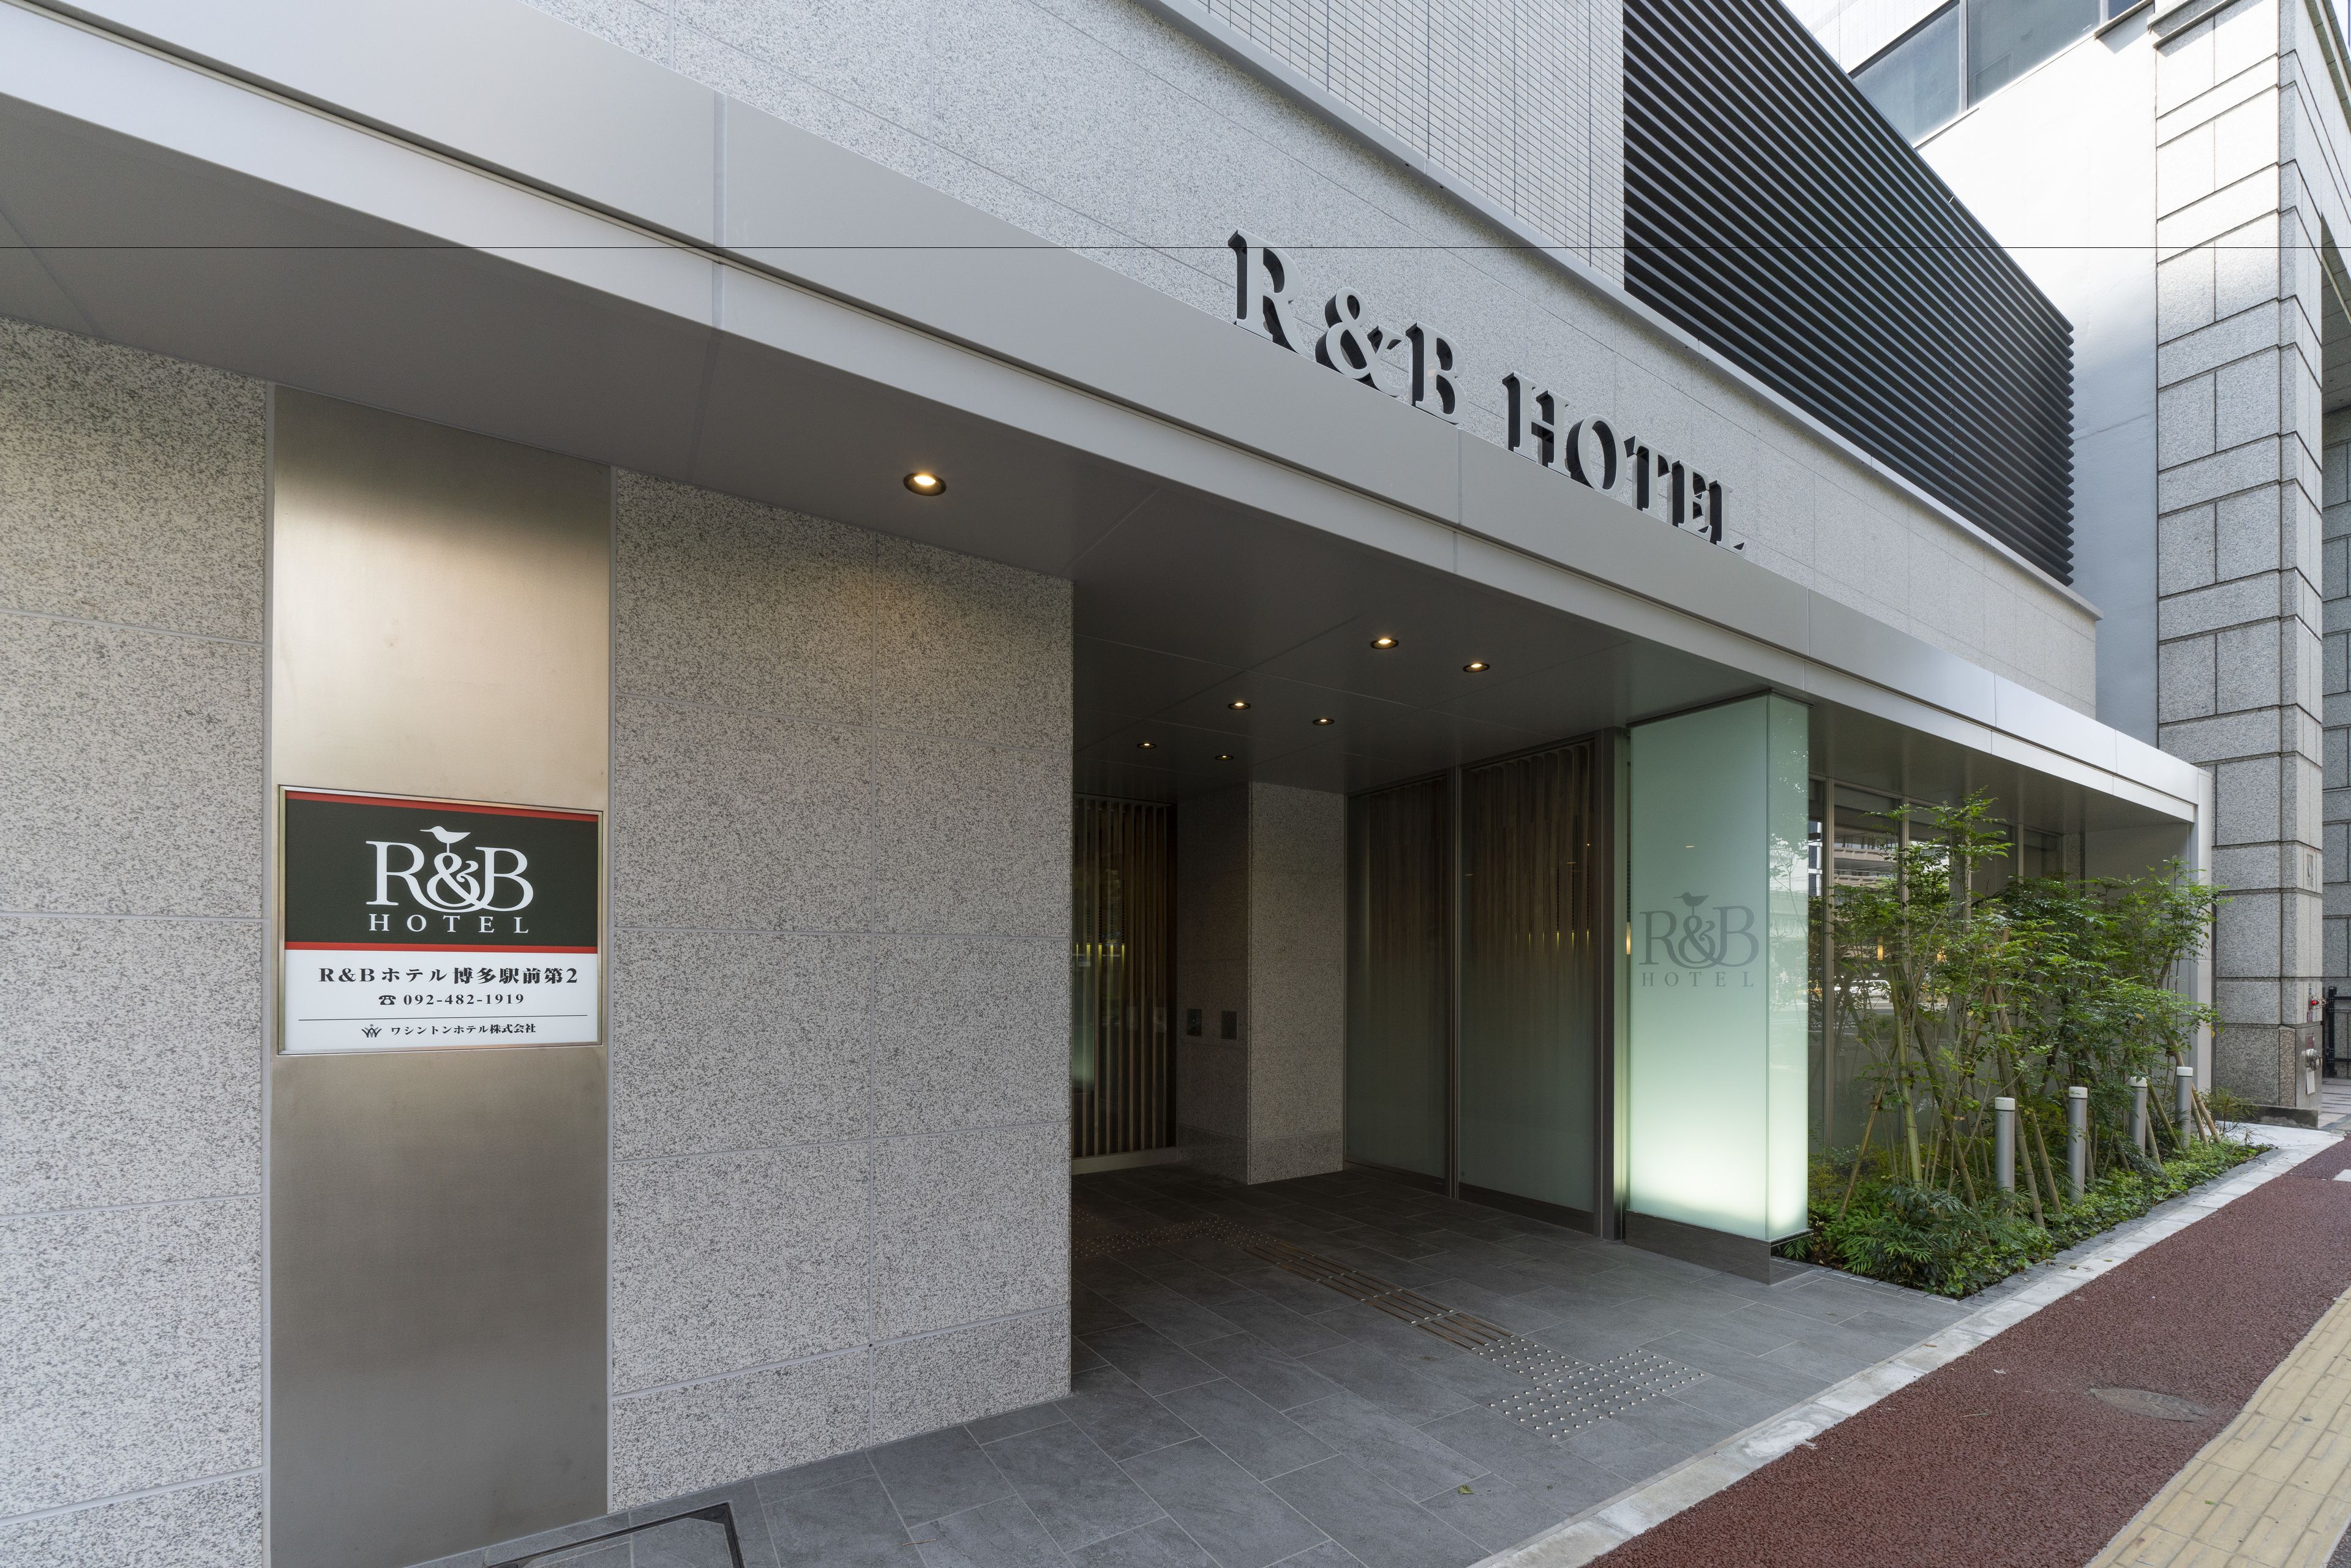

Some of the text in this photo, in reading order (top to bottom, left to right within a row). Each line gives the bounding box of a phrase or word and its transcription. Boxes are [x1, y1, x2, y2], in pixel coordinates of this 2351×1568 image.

[1228, 229, 1747, 556] R&B HOTEL
[366, 841, 534, 912] R&B
[369, 913, 529, 934] HOTEL
[1638, 905, 1759, 969] R&B
[1641, 971, 1754, 987] HOTEL
[403, 994, 525, 1005] 092-482-1919
[391, 1023, 536, 1035] ワシントンホテル株式会社
